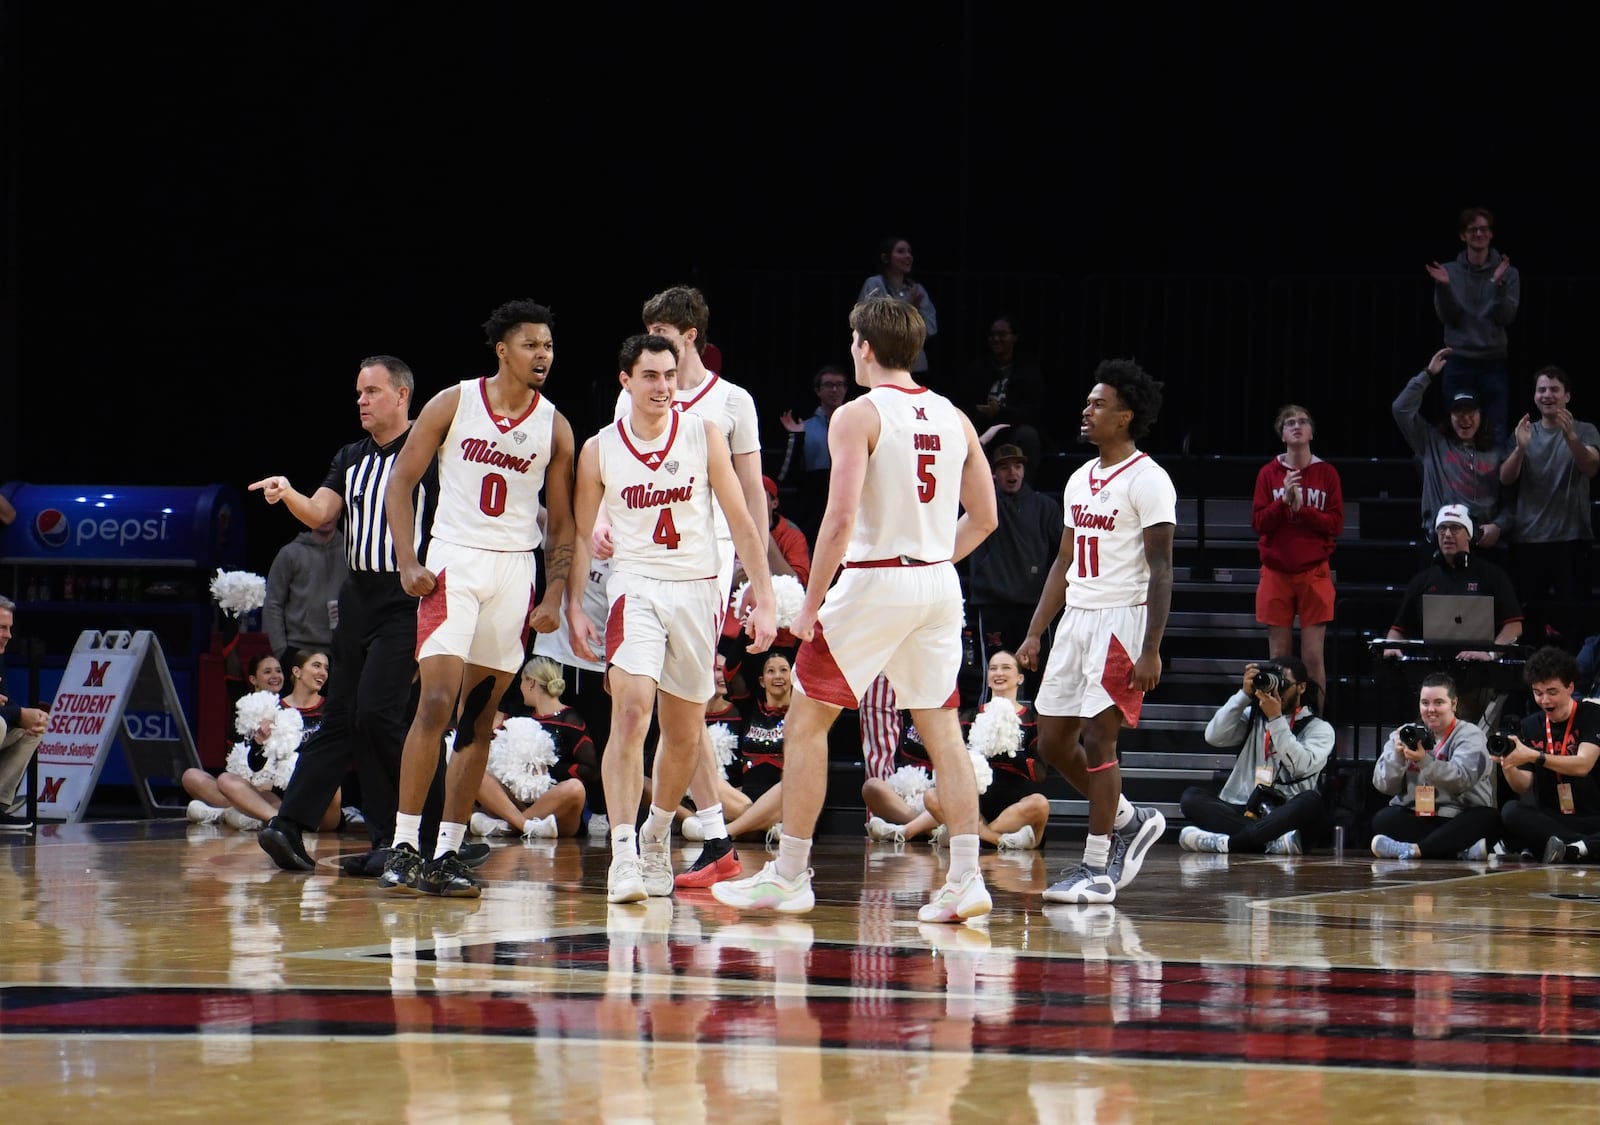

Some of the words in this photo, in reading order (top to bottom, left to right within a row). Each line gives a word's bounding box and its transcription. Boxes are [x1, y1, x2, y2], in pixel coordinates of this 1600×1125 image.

[460, 438, 537, 473] Miami
[913, 433, 941, 451] SUDER
[917, 454, 936, 503] 5
[479, 472, 508, 518] 0
[620, 477, 695, 510] Miami
[1271, 487, 1327, 512] MMI
[75, 511, 168, 547] pepsi
[652, 507, 681, 550] 4
[1070, 504, 1119, 531] Miami
[1077, 535, 1099, 577] 11
[82, 661, 112, 687] M
[54, 693, 116, 714] STUDENT
[47, 715, 105, 735] SECTION
[37, 741, 68, 757] Baseline
[67, 742, 99, 759] Seating!
[37, 777, 67, 803] M
